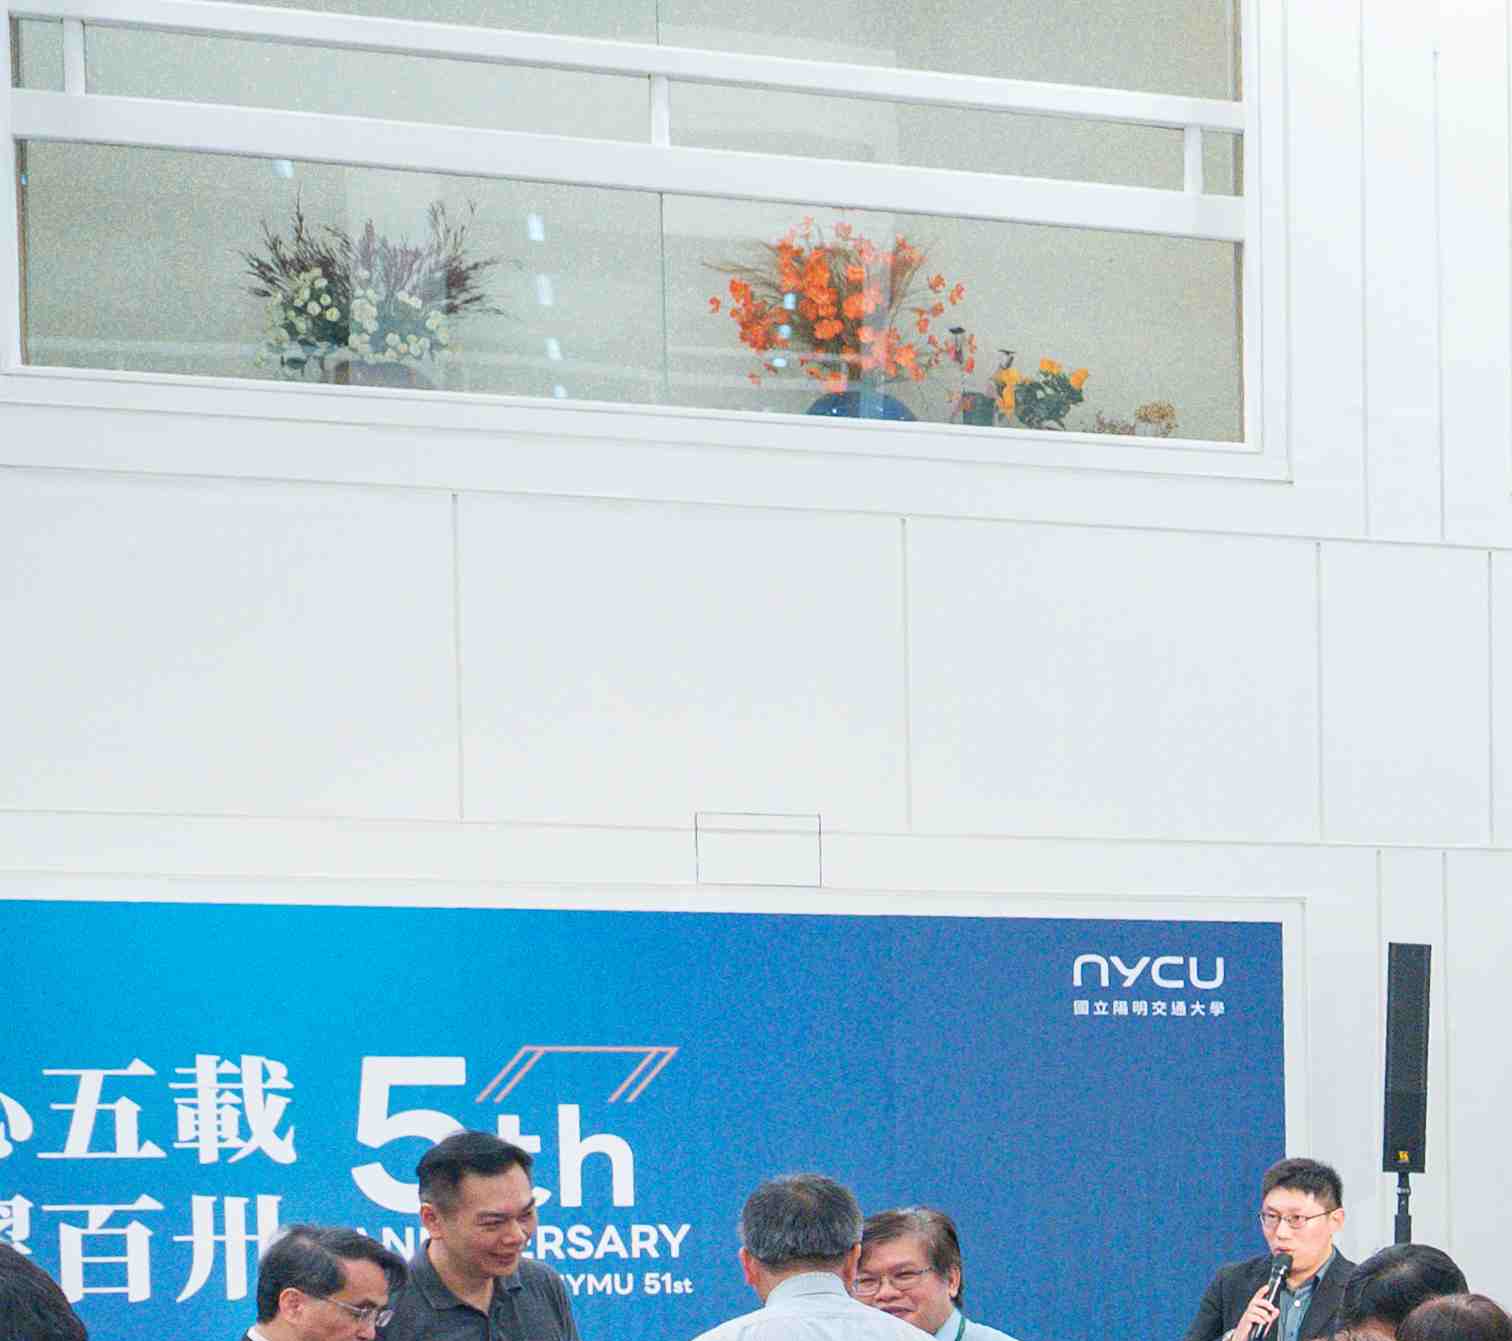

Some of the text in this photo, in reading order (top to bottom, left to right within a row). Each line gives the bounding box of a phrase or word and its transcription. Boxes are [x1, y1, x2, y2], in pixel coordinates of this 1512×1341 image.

[1073, 1000, 1225, 1016] 國立陽明交通大學
[560, 1273, 694, 1296] YMU 51st
